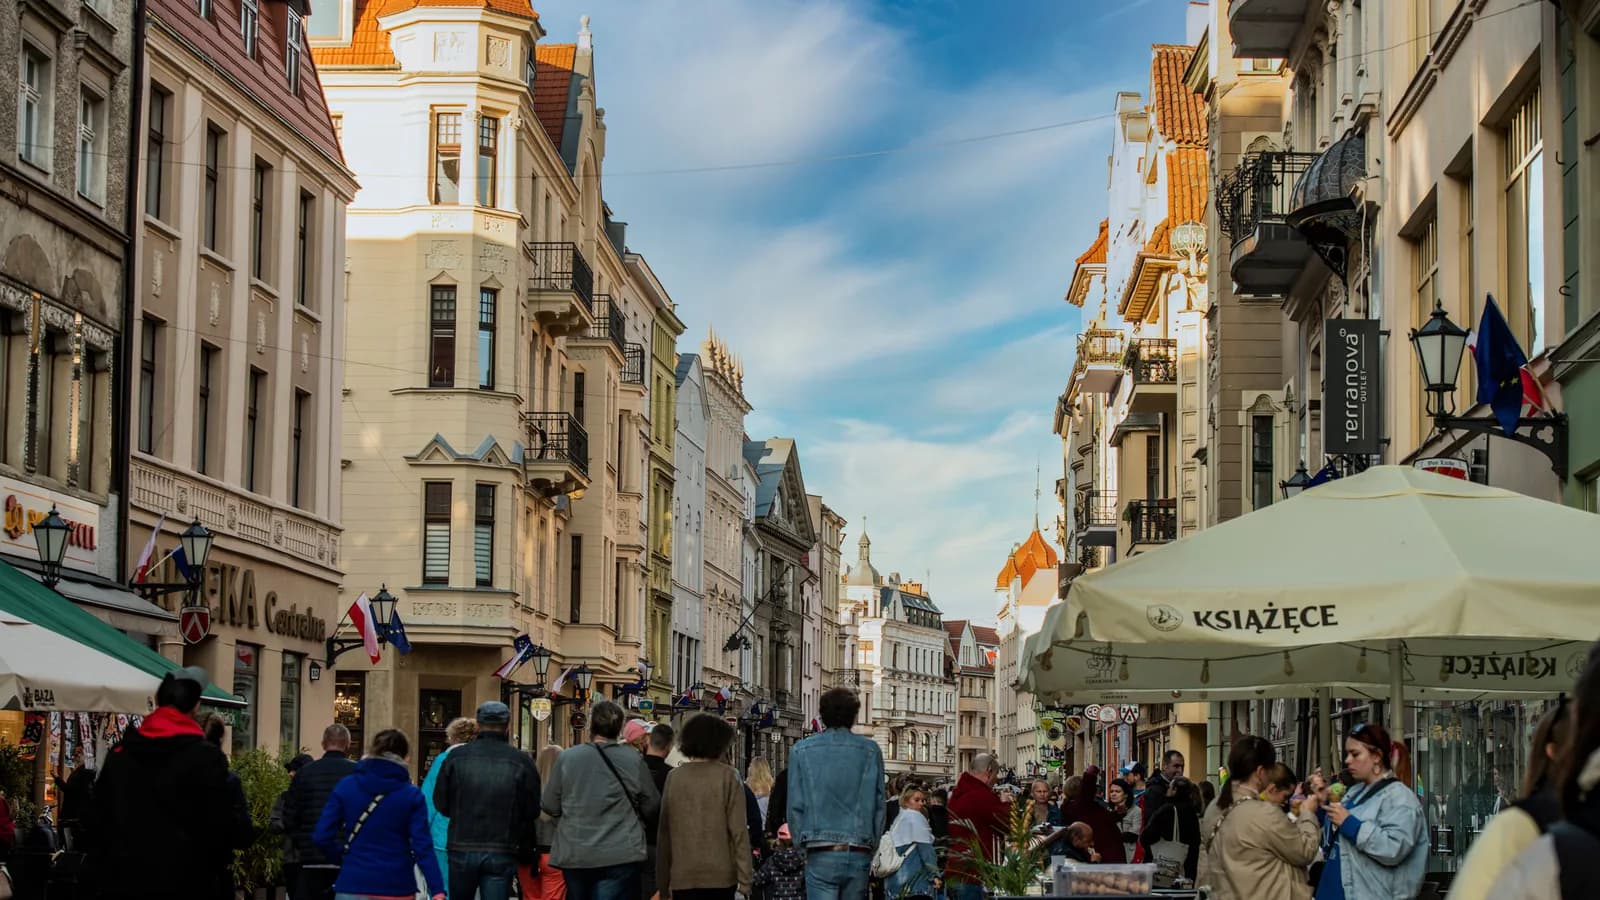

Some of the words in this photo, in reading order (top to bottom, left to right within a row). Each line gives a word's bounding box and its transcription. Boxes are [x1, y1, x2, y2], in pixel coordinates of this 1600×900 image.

[265, 590, 326, 643] Centralna
[1193, 602, 1339, 633] KSIĄŻĘCE
[34, 689, 55, 703] BAZA
